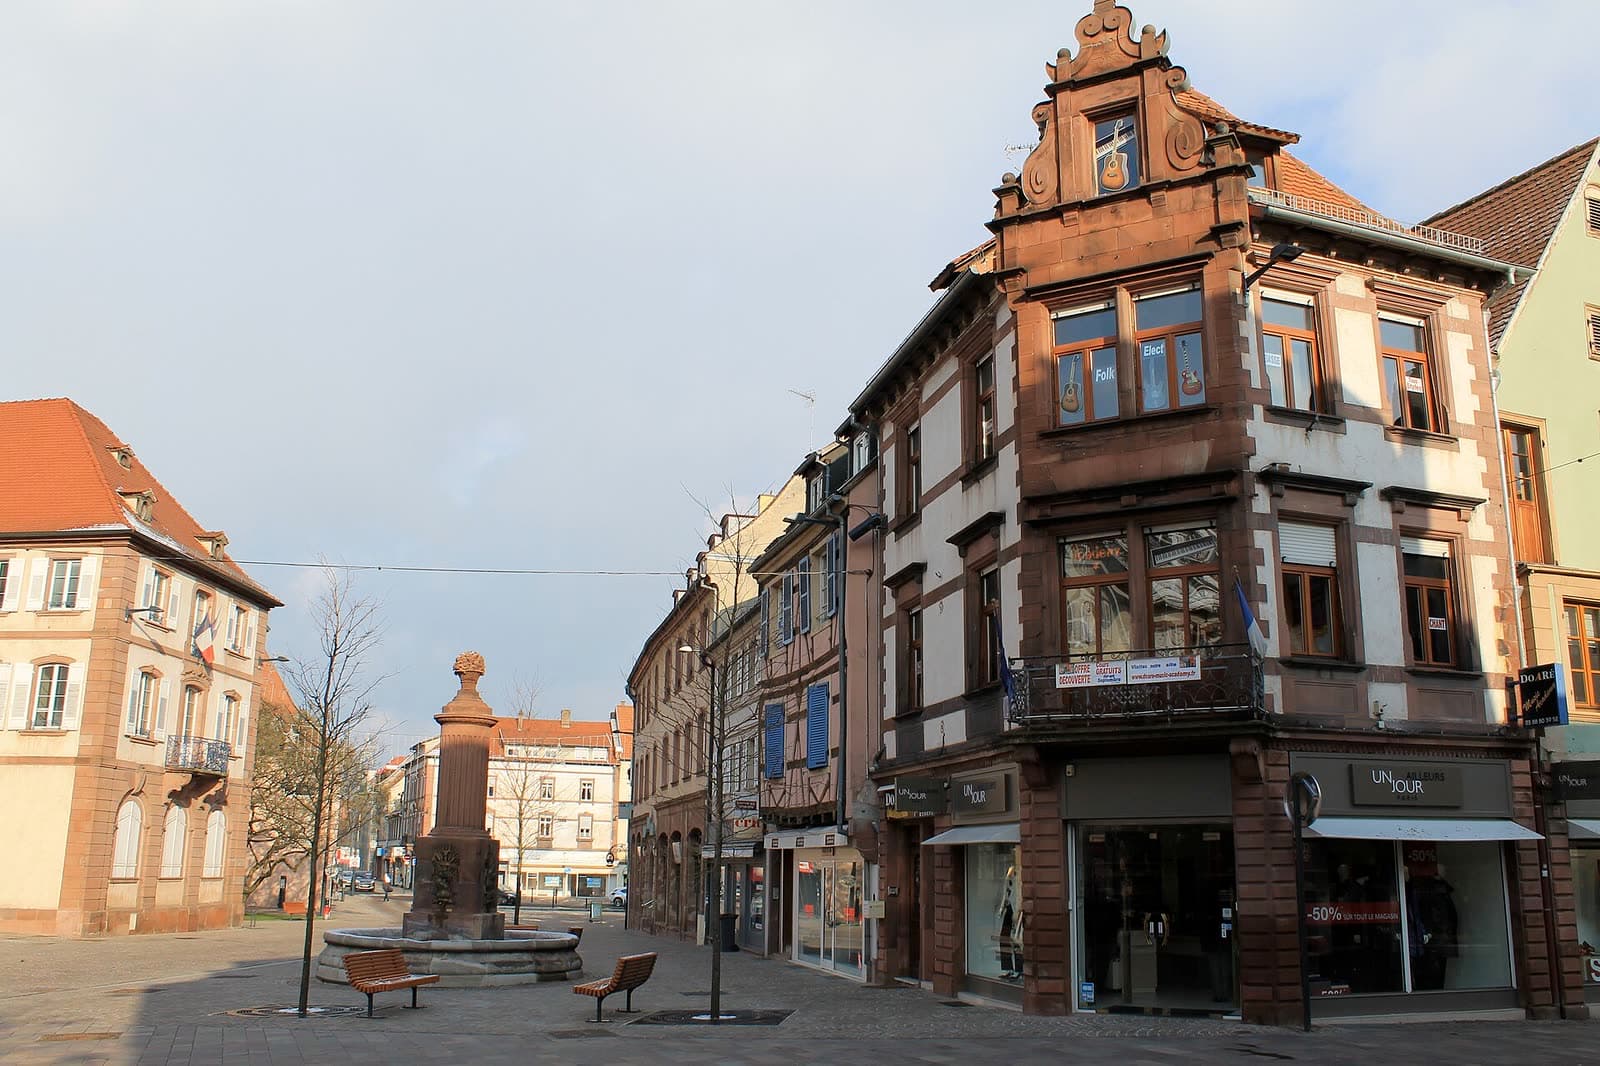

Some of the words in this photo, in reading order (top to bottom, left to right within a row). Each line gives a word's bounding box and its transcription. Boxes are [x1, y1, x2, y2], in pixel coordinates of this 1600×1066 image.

[1143, 343, 1164, 357] Elect
[1096, 367, 1115, 382] Folk
[1074, 664, 1091, 674] OFFRE
[1096, 667, 1121, 675] GRATUITS
[1372, 769, 1392, 784] UN
[1406, 771, 1445, 782] AILLEURS
[1569, 778, 1587, 786] JOUR
[1391, 779, 1424, 793] JOUR
[898, 788, 910, 796] UN
[908, 792, 927, 800] JOUR
[963, 784, 973, 797] UN
[971, 790, 986, 804] JOUR
[1307, 906, 1342, 920] -50%
[1375, 912, 1398, 920] MAGASIN
